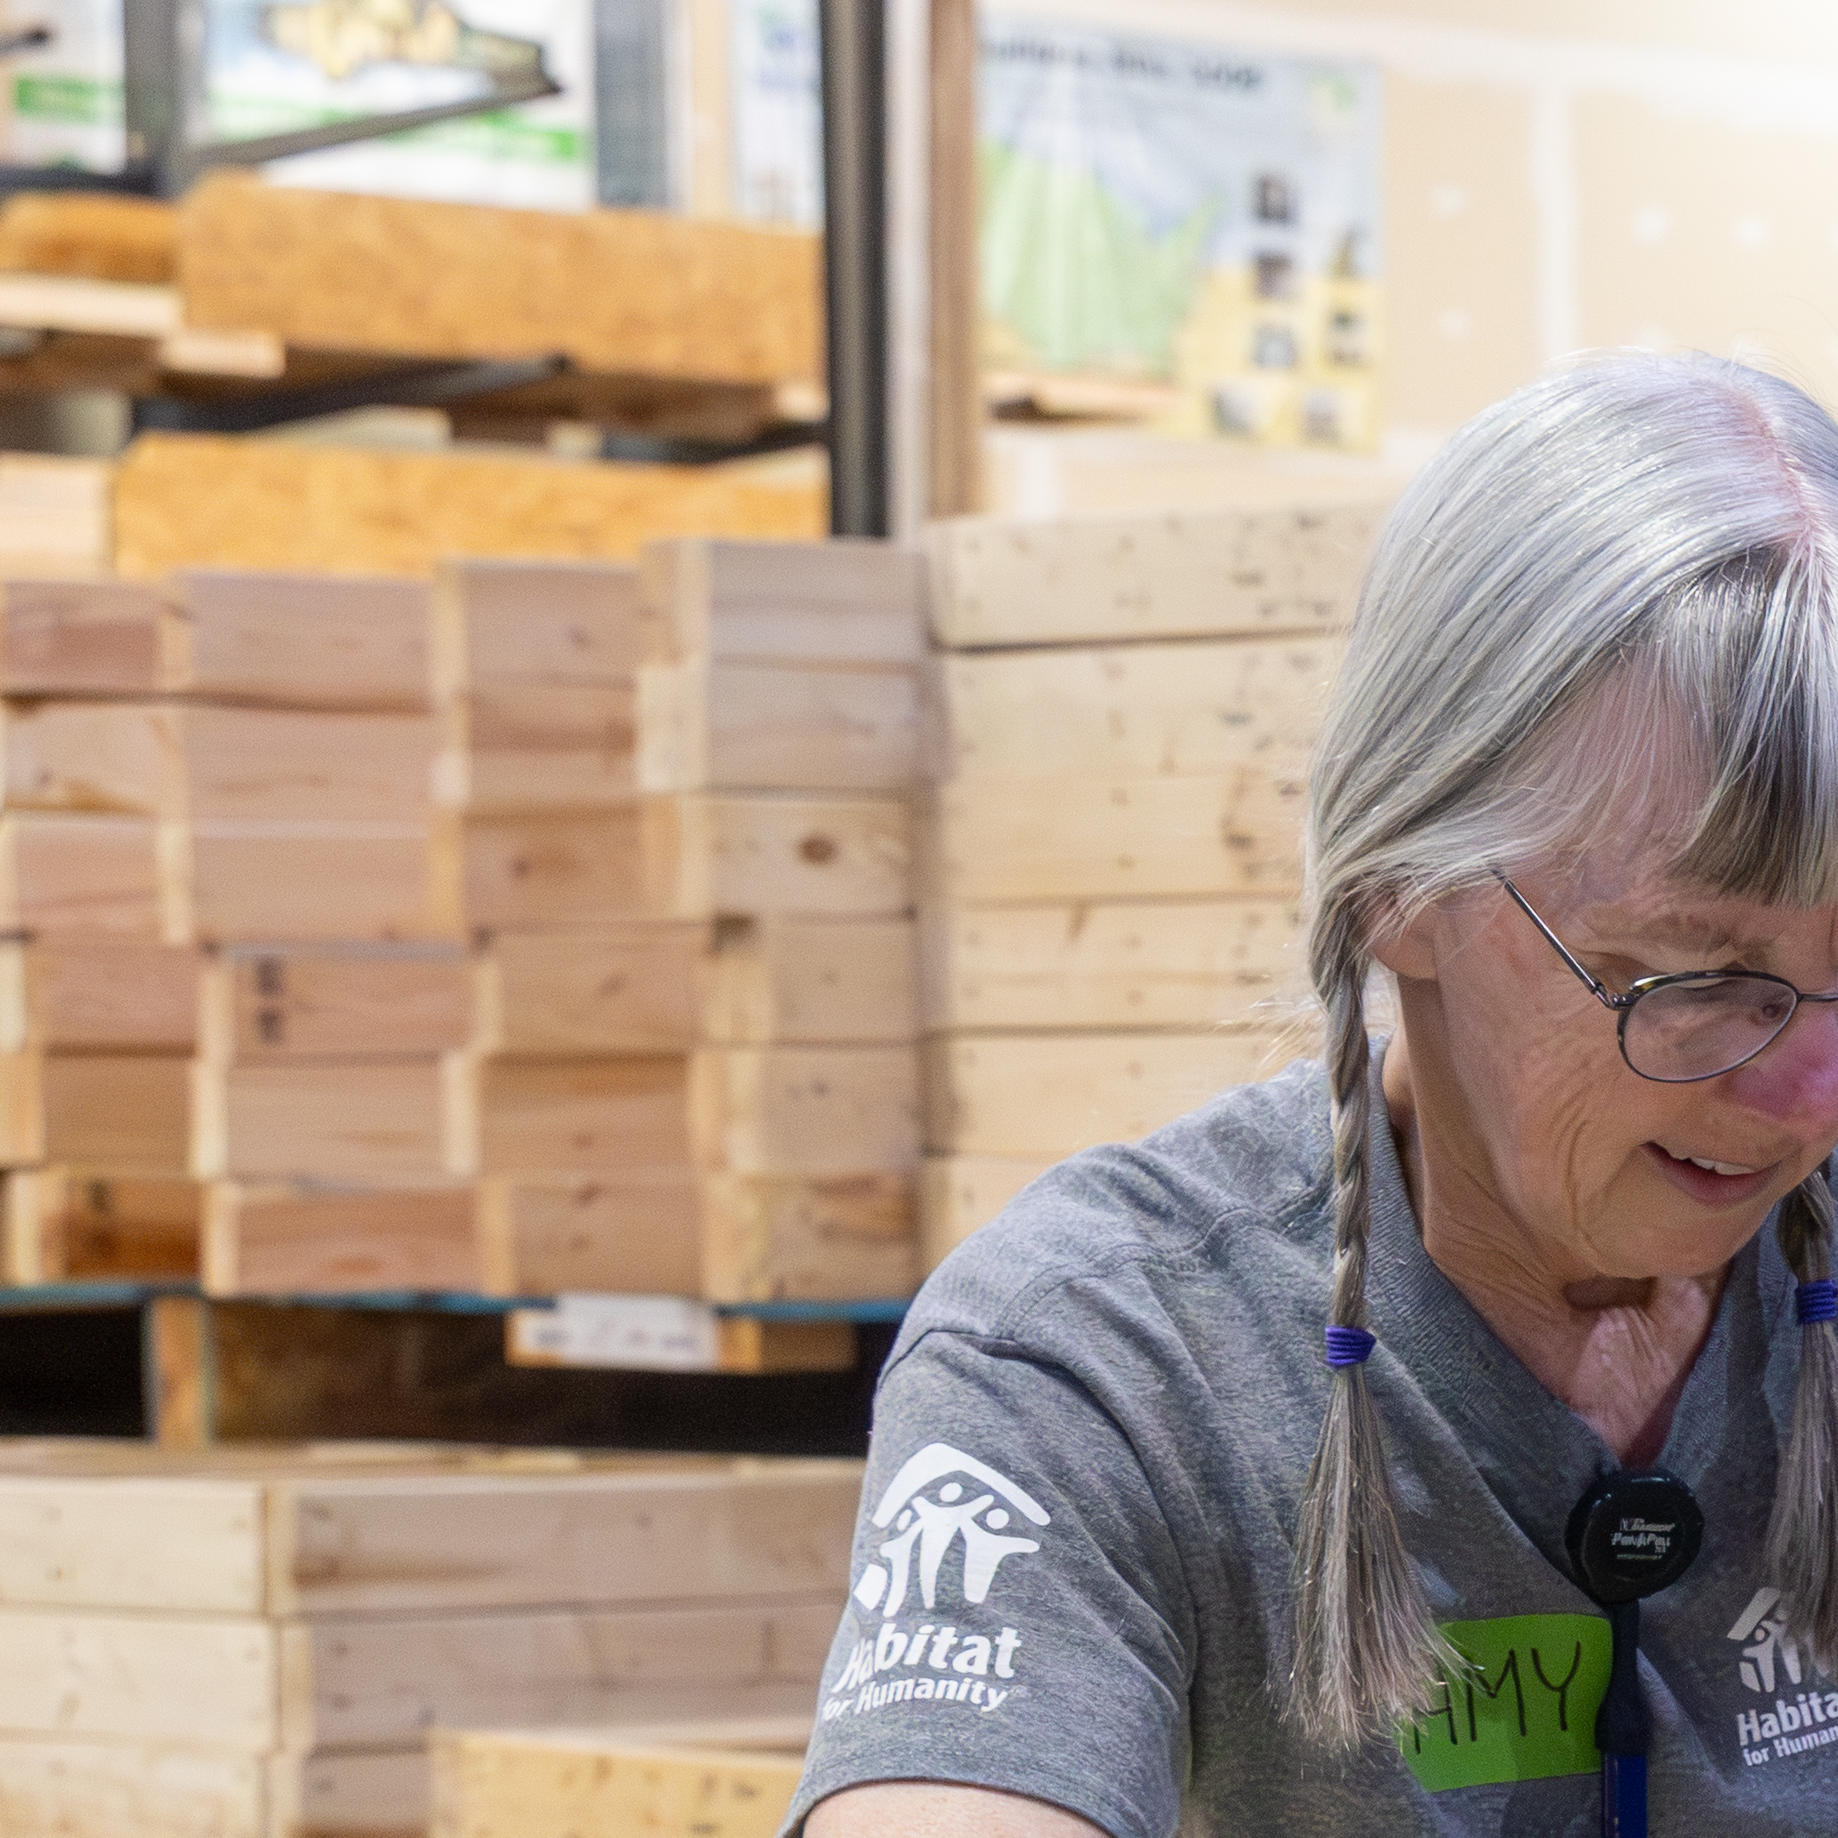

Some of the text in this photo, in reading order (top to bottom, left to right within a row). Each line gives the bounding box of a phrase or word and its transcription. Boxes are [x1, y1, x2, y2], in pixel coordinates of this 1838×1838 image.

[831, 1622, 1022, 1693] Habitat
[854, 1677, 1008, 1712] Humanity
[1742, 1747, 1770, 1766] for
